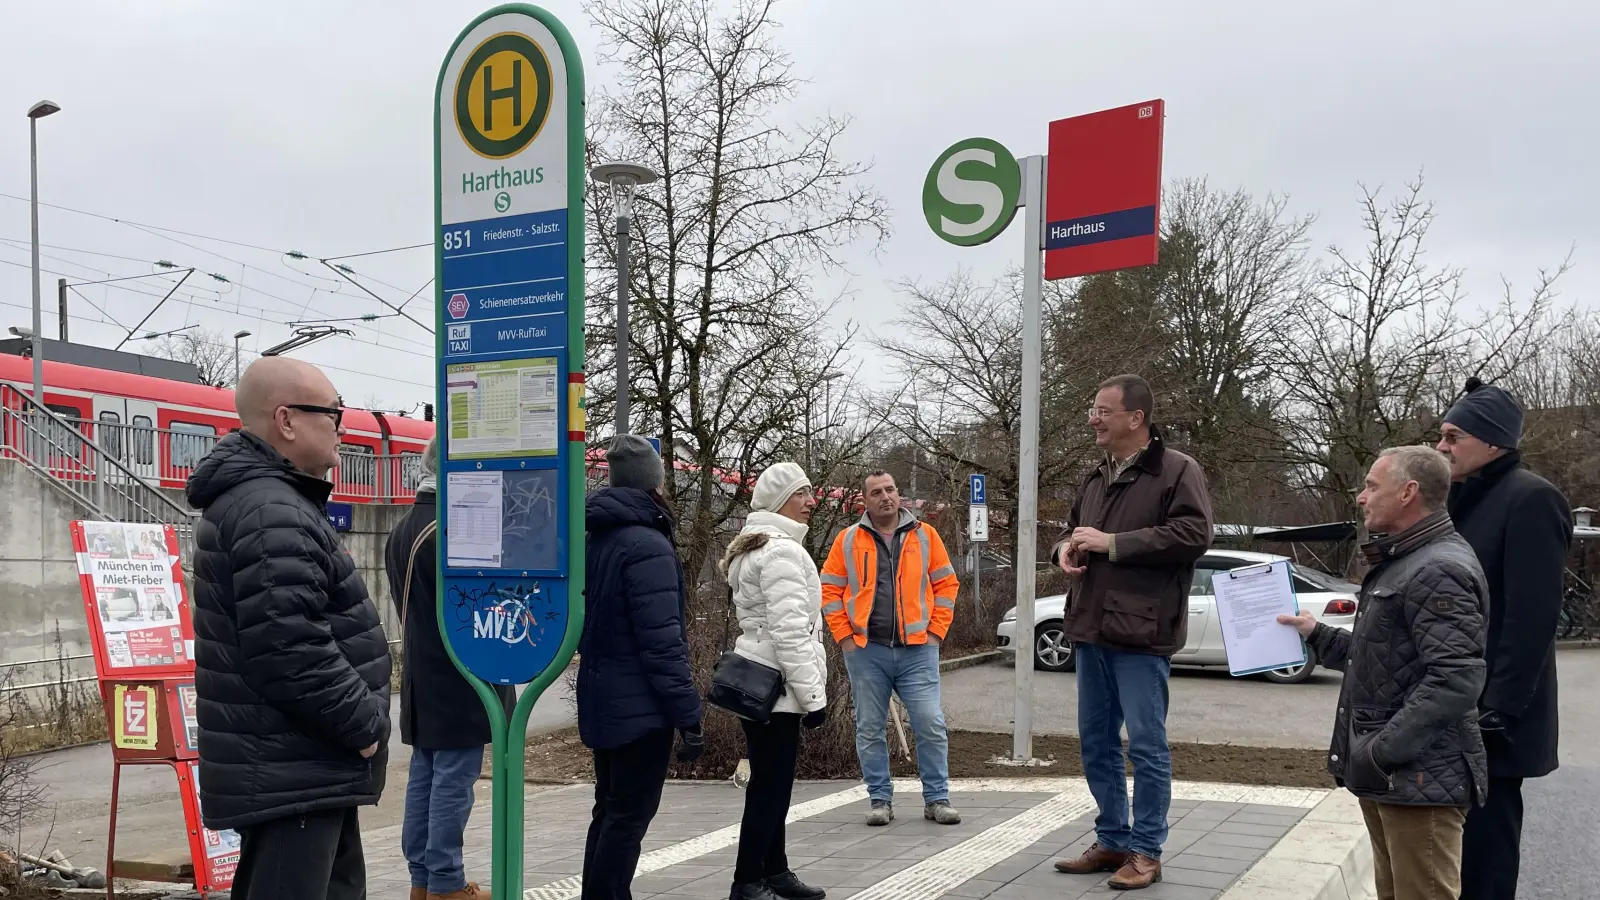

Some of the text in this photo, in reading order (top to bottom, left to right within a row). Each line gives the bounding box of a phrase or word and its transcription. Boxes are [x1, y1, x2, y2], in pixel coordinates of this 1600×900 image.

[483, 59, 522, 132] H
[1140, 107, 1152, 117] DB
[462, 166, 544, 194] Harthaus
[936, 148, 1004, 237] S
[443, 229, 471, 251] 851
[483, 228, 524, 241] Friedenstr.
[531, 223, 560, 236] Salzstr.
[1051, 220, 1106, 240] Harthaus
[451, 300, 467, 310] SEV
[479, 291, 564, 310] Schienenersatzverkehr
[452, 327, 466, 339] Ruf
[498, 327, 547, 341] MVV-RufTaxi
[450, 340, 469, 352] TAXI
[974, 478, 982, 501] P
[97, 561, 164, 572] München im
[102, 574, 164, 585] Miet-Fieber
[124, 694, 146, 733] tz
[214, 855, 239, 866] LISA FITZ
